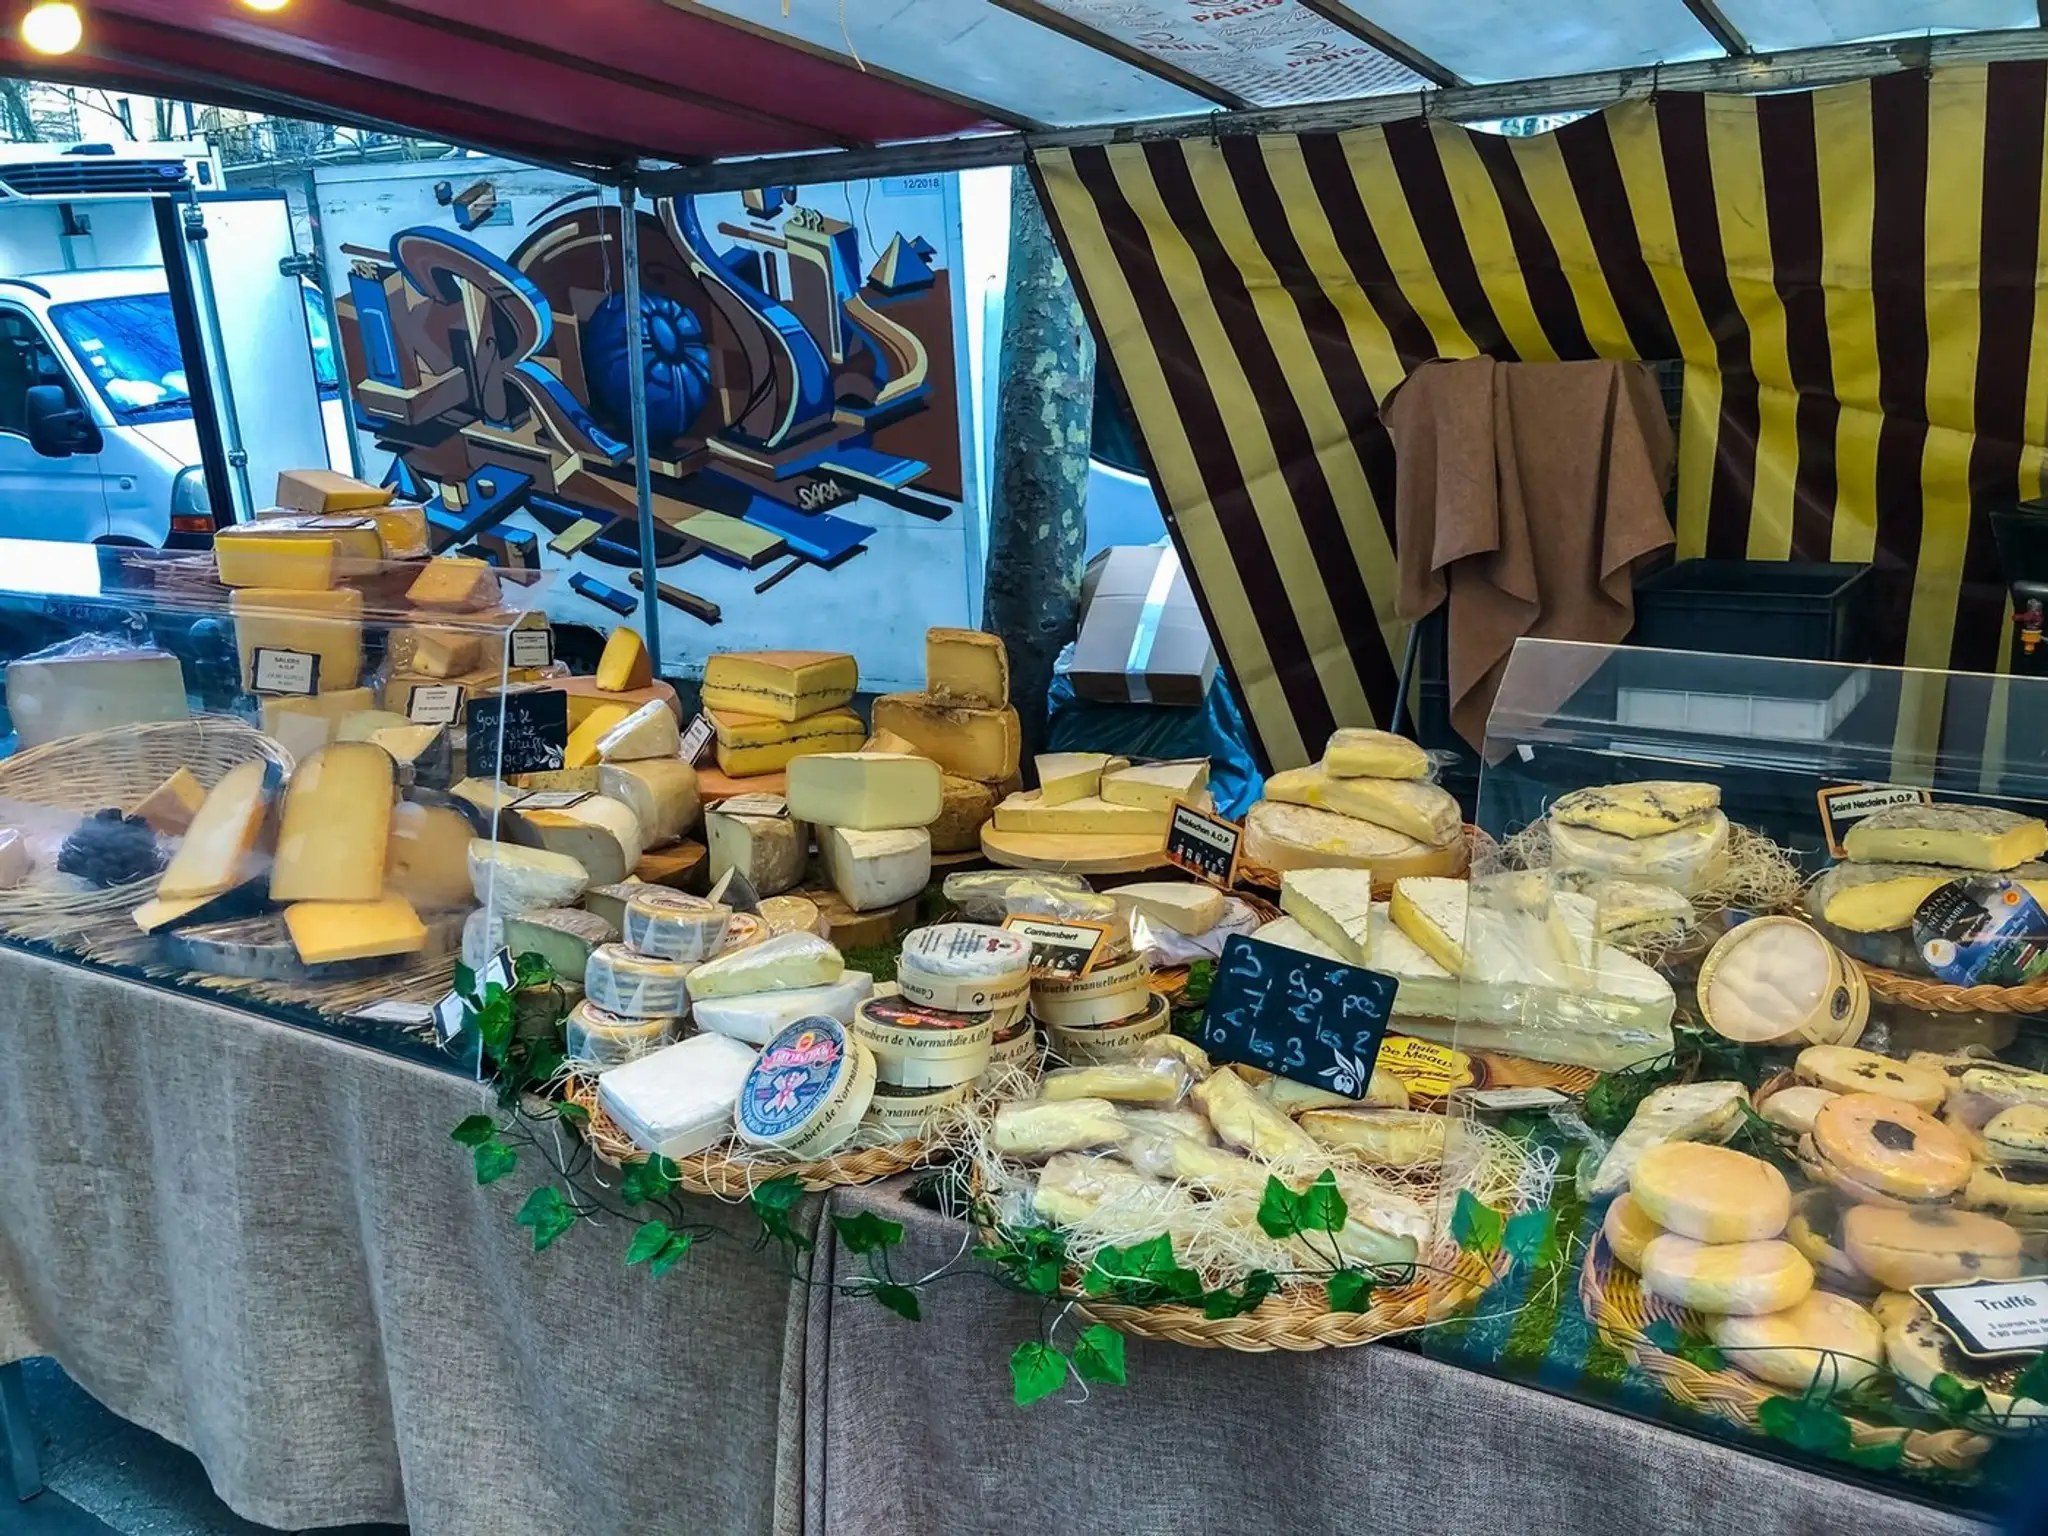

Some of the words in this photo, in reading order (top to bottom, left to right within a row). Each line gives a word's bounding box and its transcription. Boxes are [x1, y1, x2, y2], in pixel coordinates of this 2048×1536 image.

[1191, 0, 1284, 22] PARIS
[1287, 47, 1370, 68] PARIS
[902, 178, 940, 189] 12/2018
[1831, 801, 1853, 813] Saint
[1920, 889, 1954, 918] SAINT
[1024, 926, 1079, 941] Camembert
[890, 1034, 904, 1046] de
[906, 1033, 968, 1049] Normandie
[1406, 1042, 1440, 1056] Brie
[824, 1108, 837, 1123] de
[1974, 1294, 2038, 1312] Truffé
